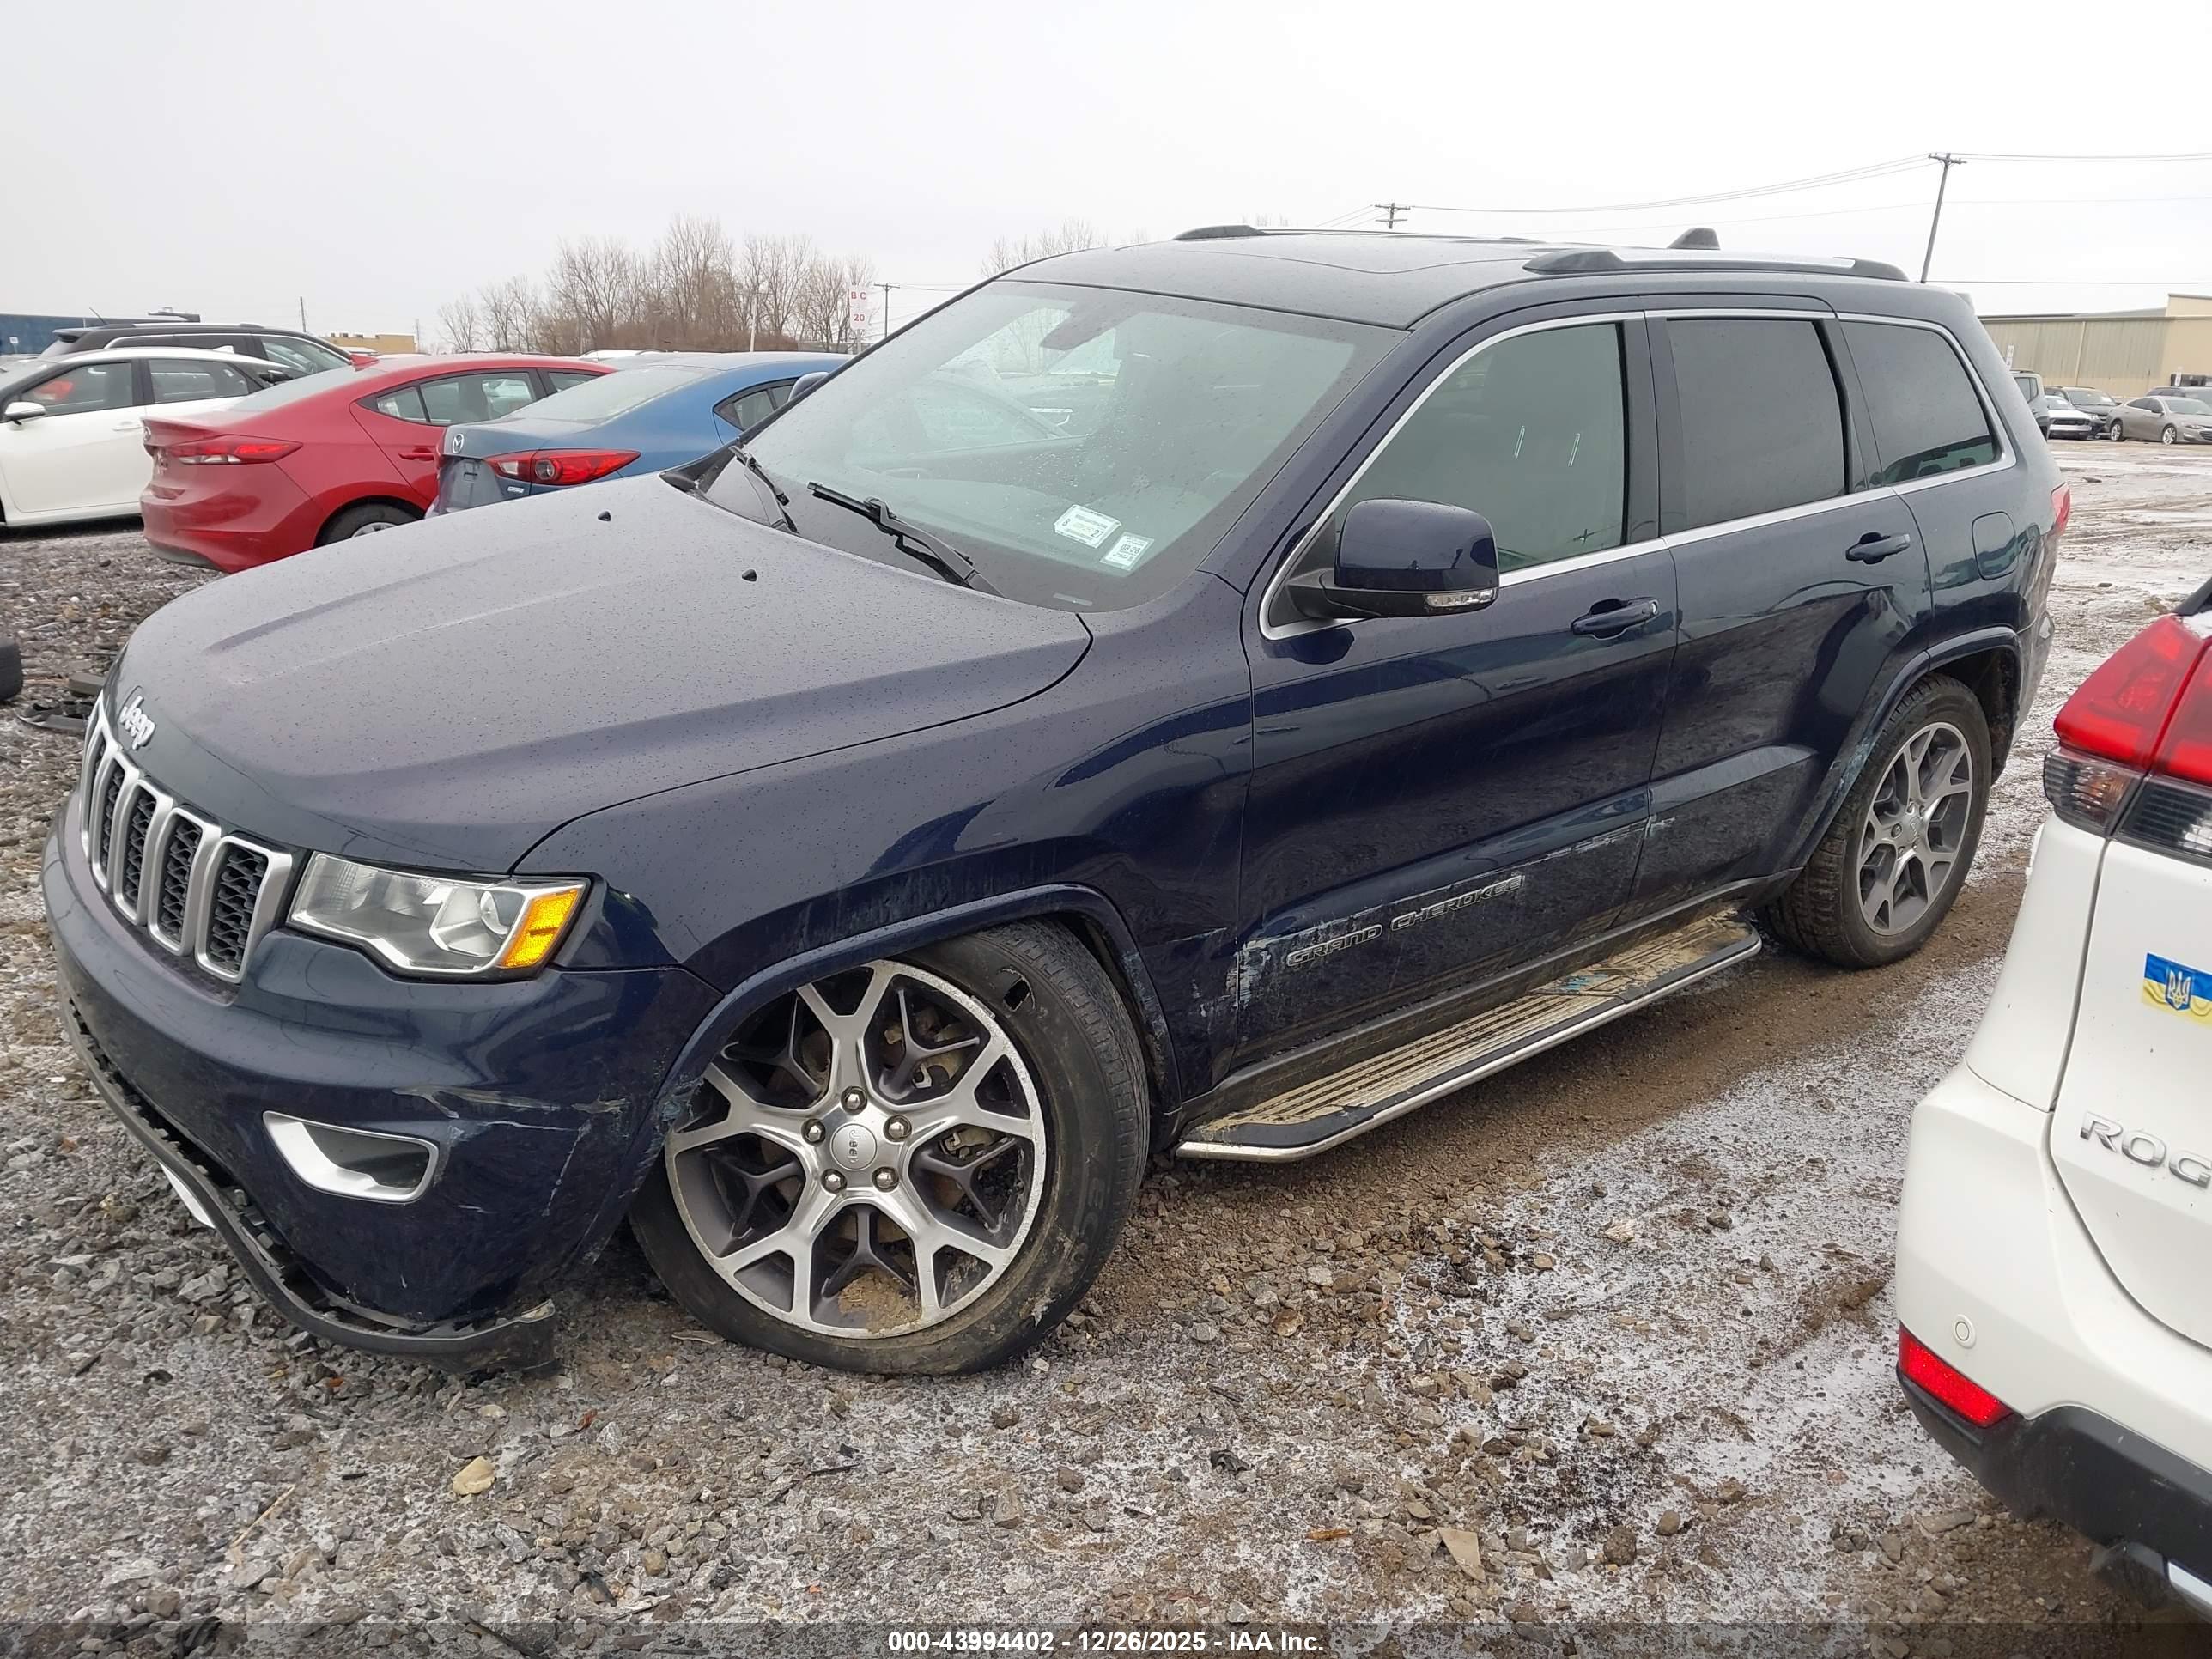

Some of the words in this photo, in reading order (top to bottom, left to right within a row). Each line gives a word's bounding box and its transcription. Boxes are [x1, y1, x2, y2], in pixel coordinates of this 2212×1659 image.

[854, 313, 866, 322] 20
[119, 695, 155, 750] Jeep
[1287, 924, 1383, 967] GRAND
[1391, 875, 1524, 932] CHEROKEE
[846, 1129, 861, 1163] Jeep
